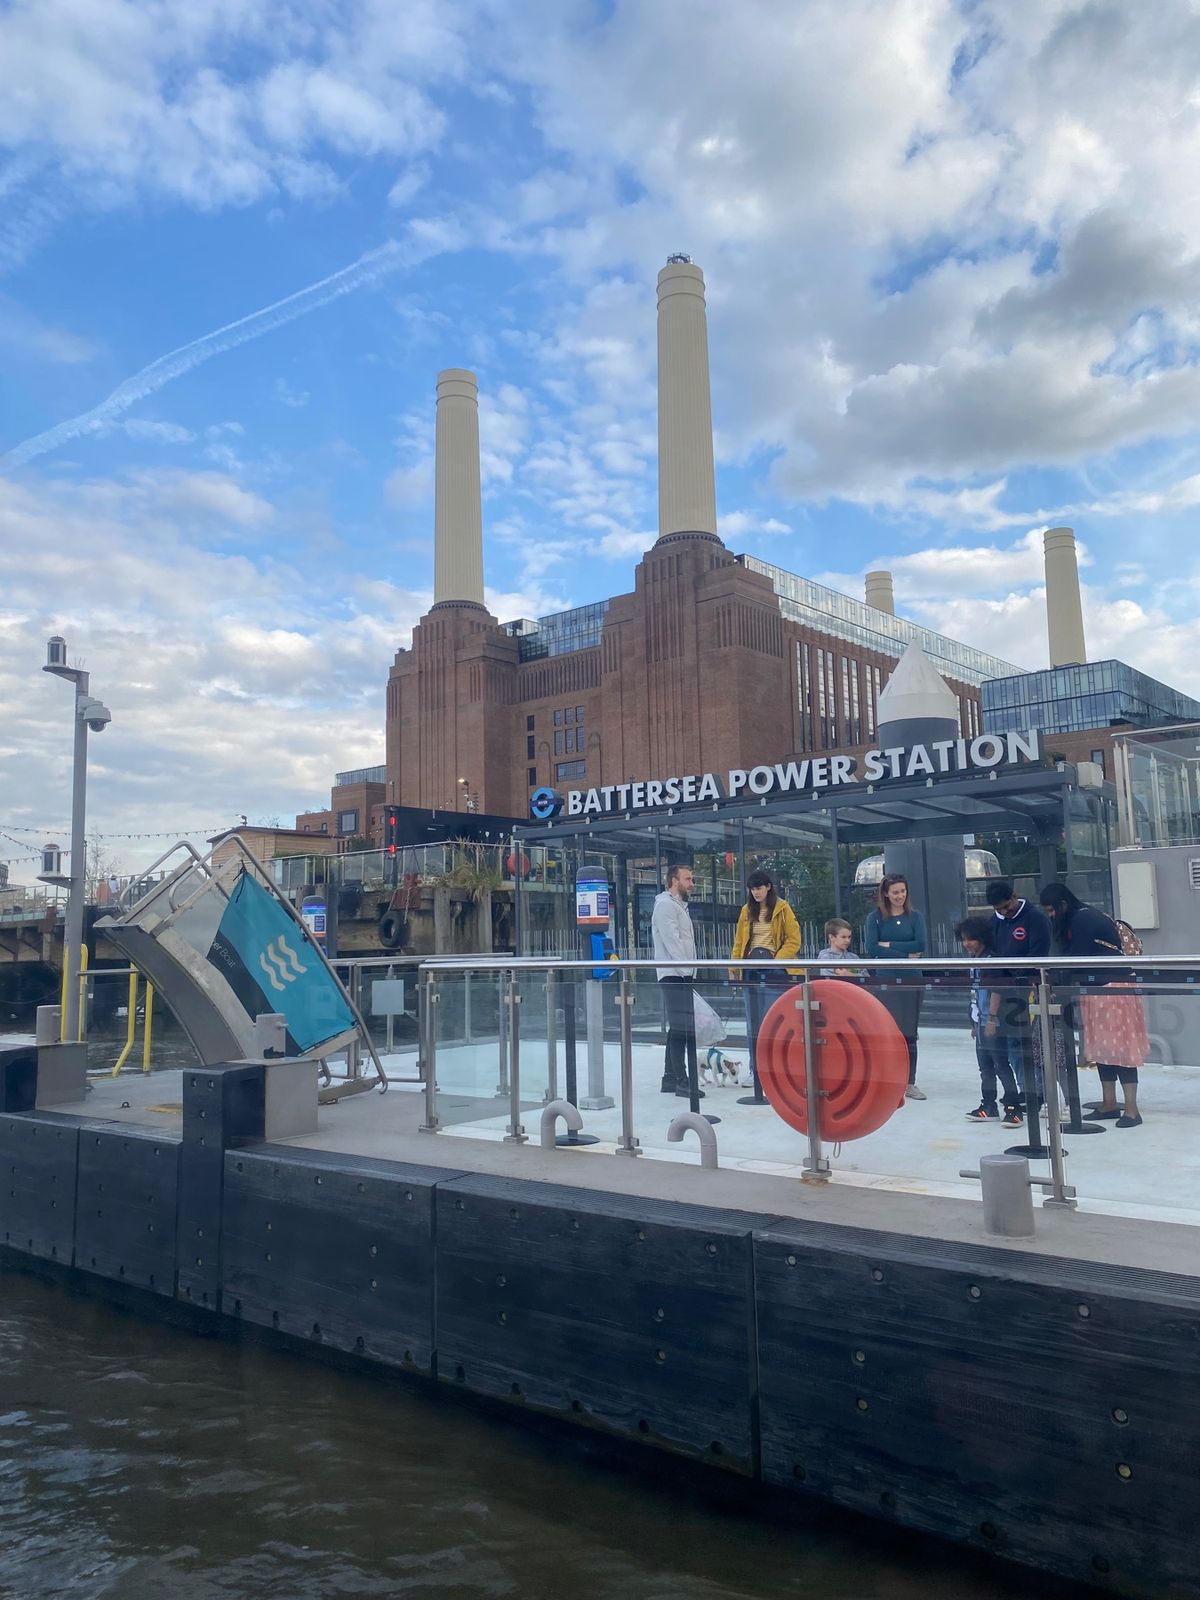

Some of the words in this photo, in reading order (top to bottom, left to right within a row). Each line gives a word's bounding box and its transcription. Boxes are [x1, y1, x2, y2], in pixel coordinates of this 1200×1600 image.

[568, 773, 720, 815] BATTERSEA
[728, 755, 859, 797] POWER
[864, 729, 1040, 781] STATION
[219, 948, 236, 968] Boat
